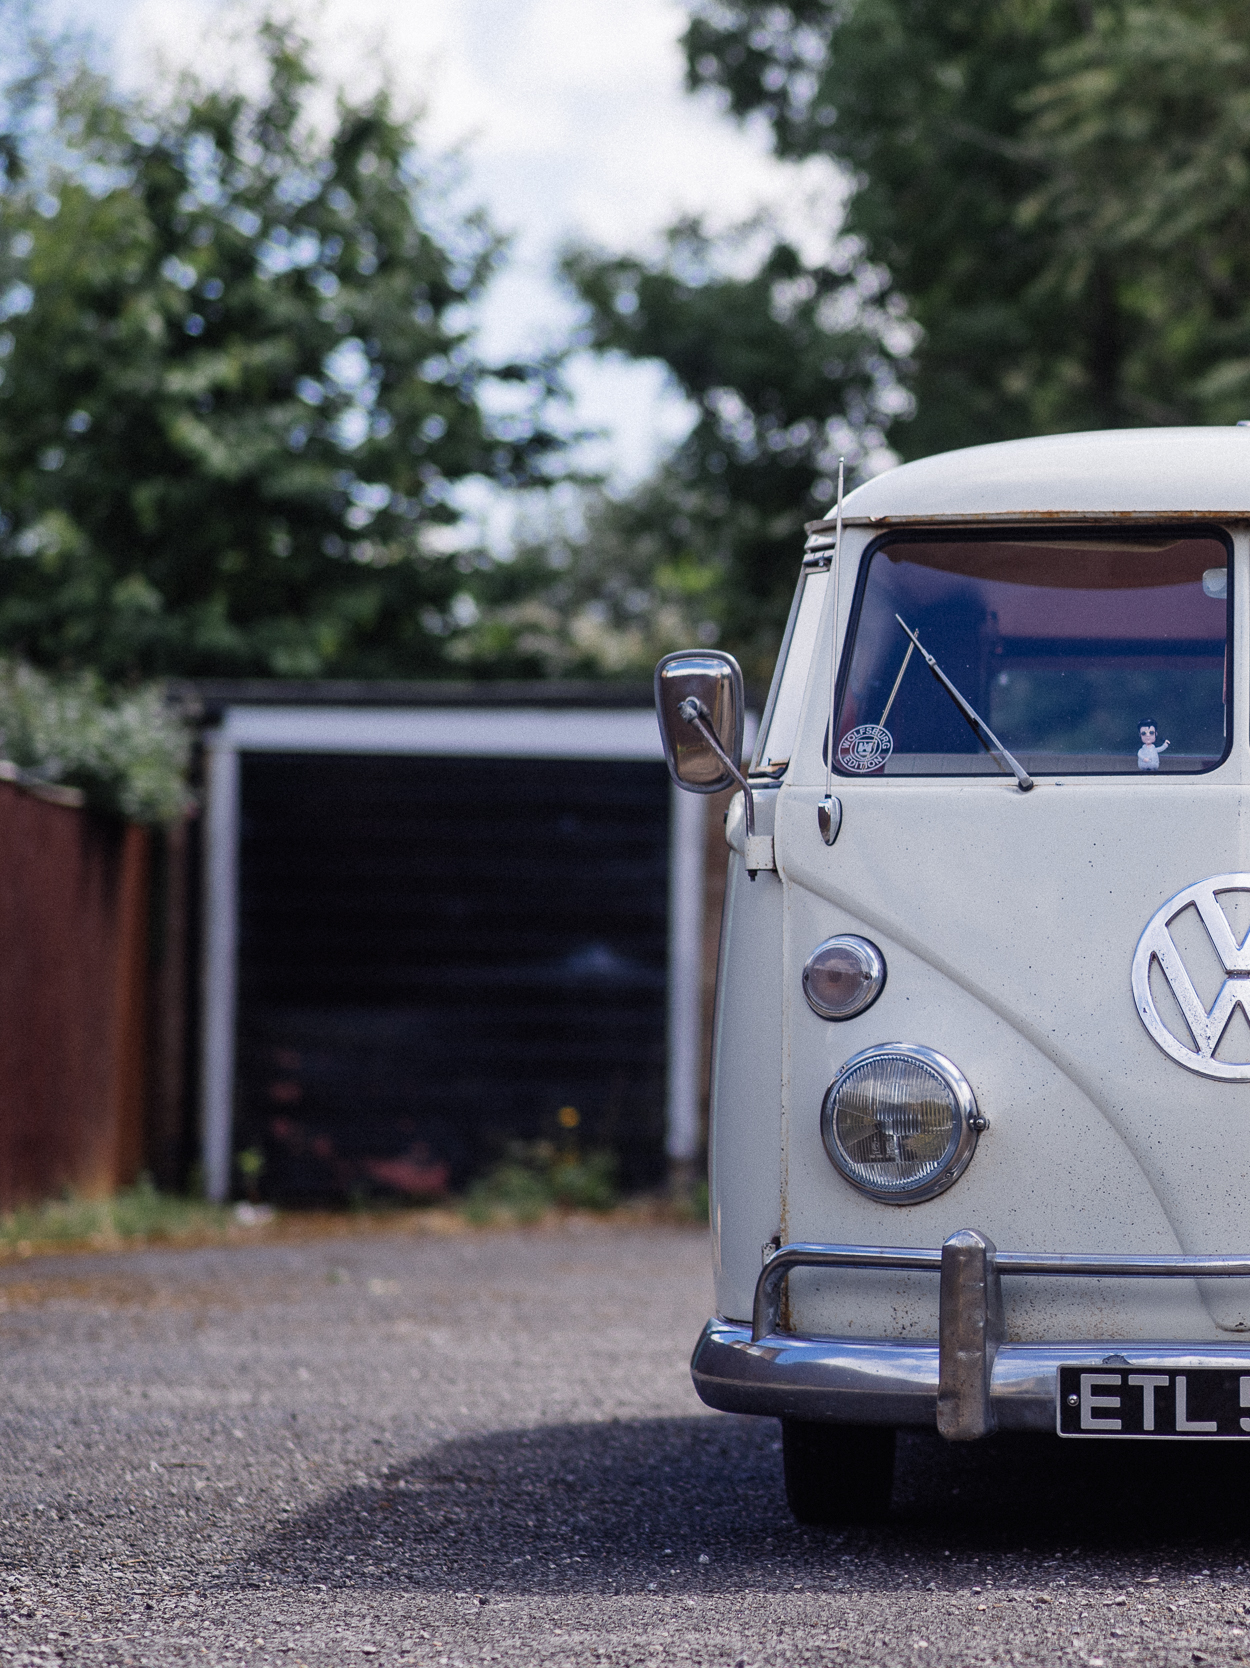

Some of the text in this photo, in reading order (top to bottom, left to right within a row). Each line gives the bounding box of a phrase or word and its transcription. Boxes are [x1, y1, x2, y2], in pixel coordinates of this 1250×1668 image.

[841, 727, 890, 749] WOLFSBURG
[843, 755, 883, 769] EDITION
[1080, 1373, 1218, 1432] ETL
